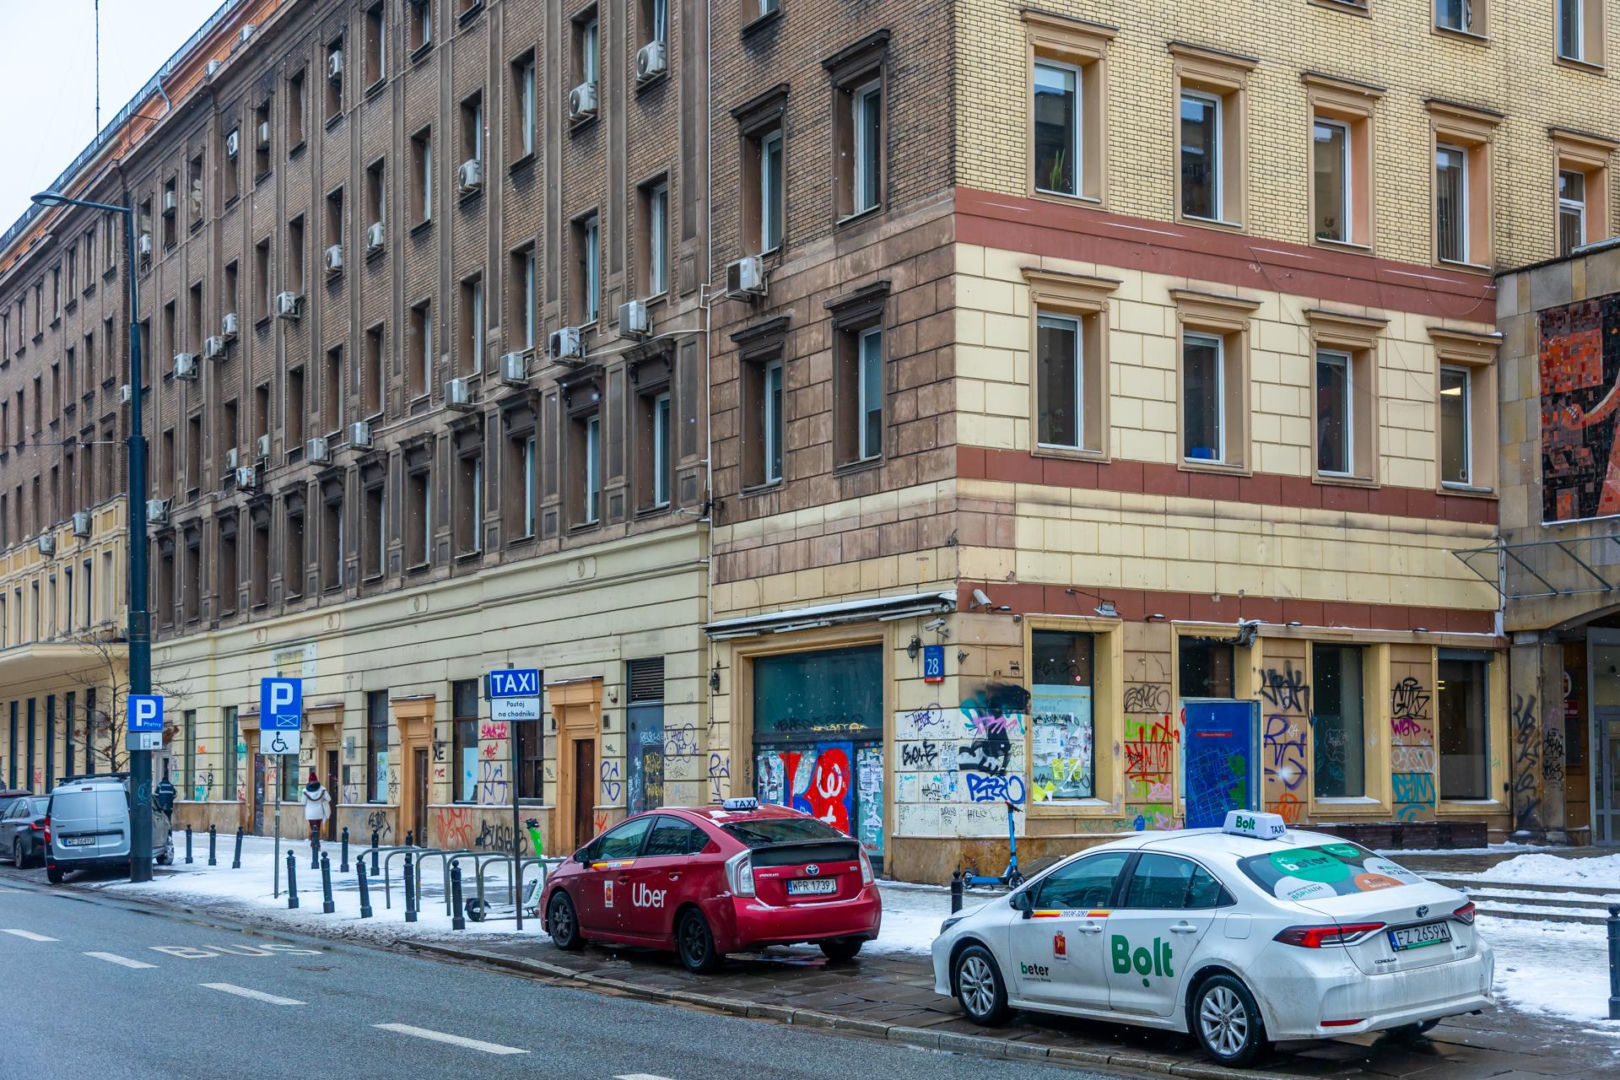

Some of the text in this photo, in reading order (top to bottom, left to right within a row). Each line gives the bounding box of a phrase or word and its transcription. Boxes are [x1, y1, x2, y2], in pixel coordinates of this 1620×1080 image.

[927, 658, 939, 675] 28
[492, 673, 536, 693] TAXI
[270, 682, 294, 714] P
[136, 699, 156, 727] P
[1235, 815, 1256, 833] Bolt
[1270, 824, 1285, 834] TAXI
[632, 883, 667, 908] Uber
[792, 881, 810, 891] WPR
[1396, 923, 1447, 946] FZ 2659W
[148, 944, 323, 958] BUS
[1020, 961, 1049, 976] beter
[1111, 934, 1174, 988] Bolt
